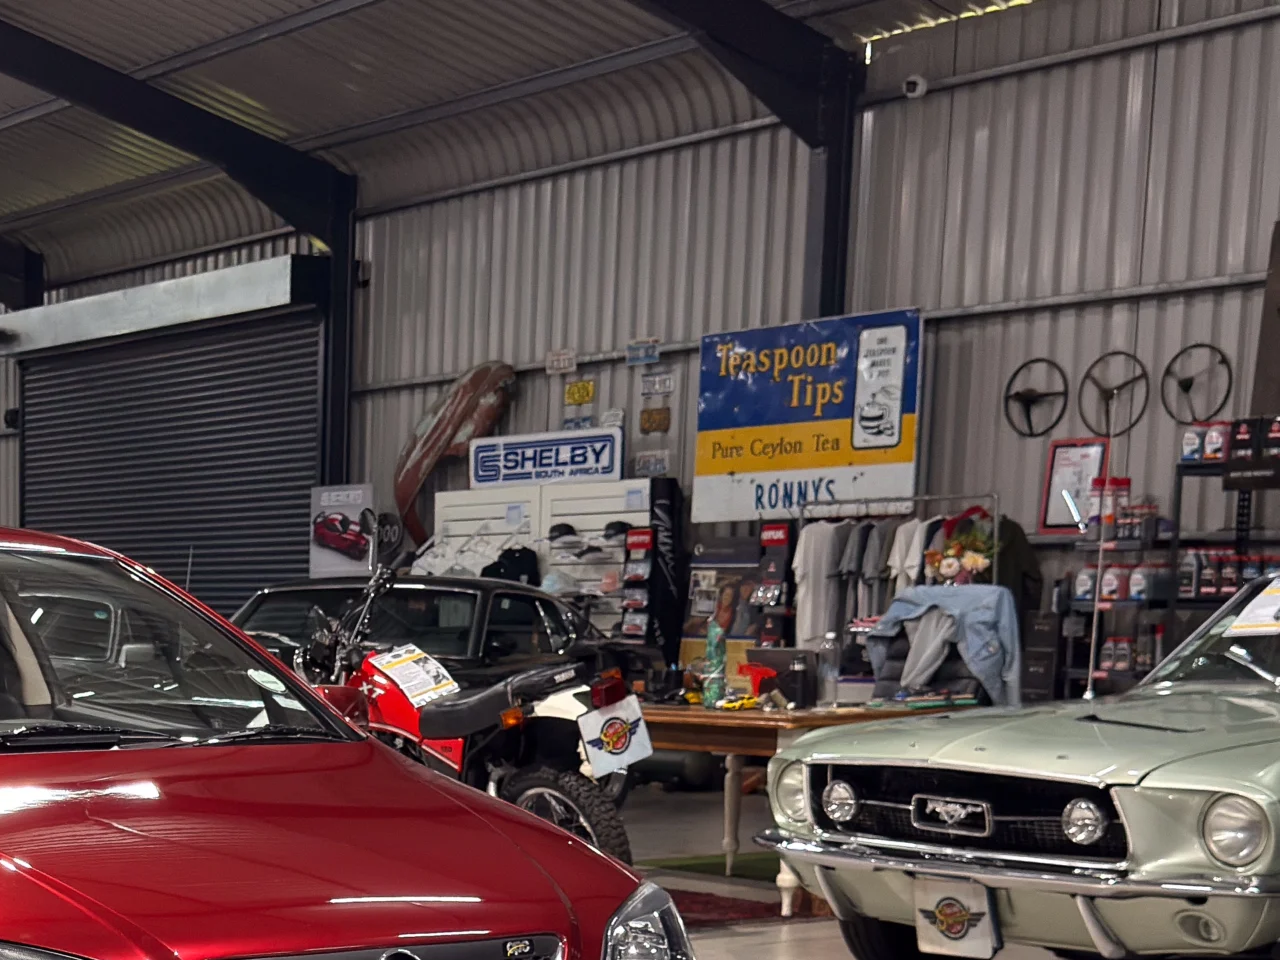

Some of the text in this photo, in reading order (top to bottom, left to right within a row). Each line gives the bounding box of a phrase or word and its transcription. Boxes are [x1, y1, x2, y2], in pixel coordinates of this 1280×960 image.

[716, 342, 838, 382] Teaspoon
[787, 374, 846, 417] Tips
[503, 443, 608, 471] SHELBY
[711, 434, 841, 459] Pure Ceylon Tea
[534, 466, 600, 480] SOUTH AFRICA
[358, 681, 386, 699] XT
